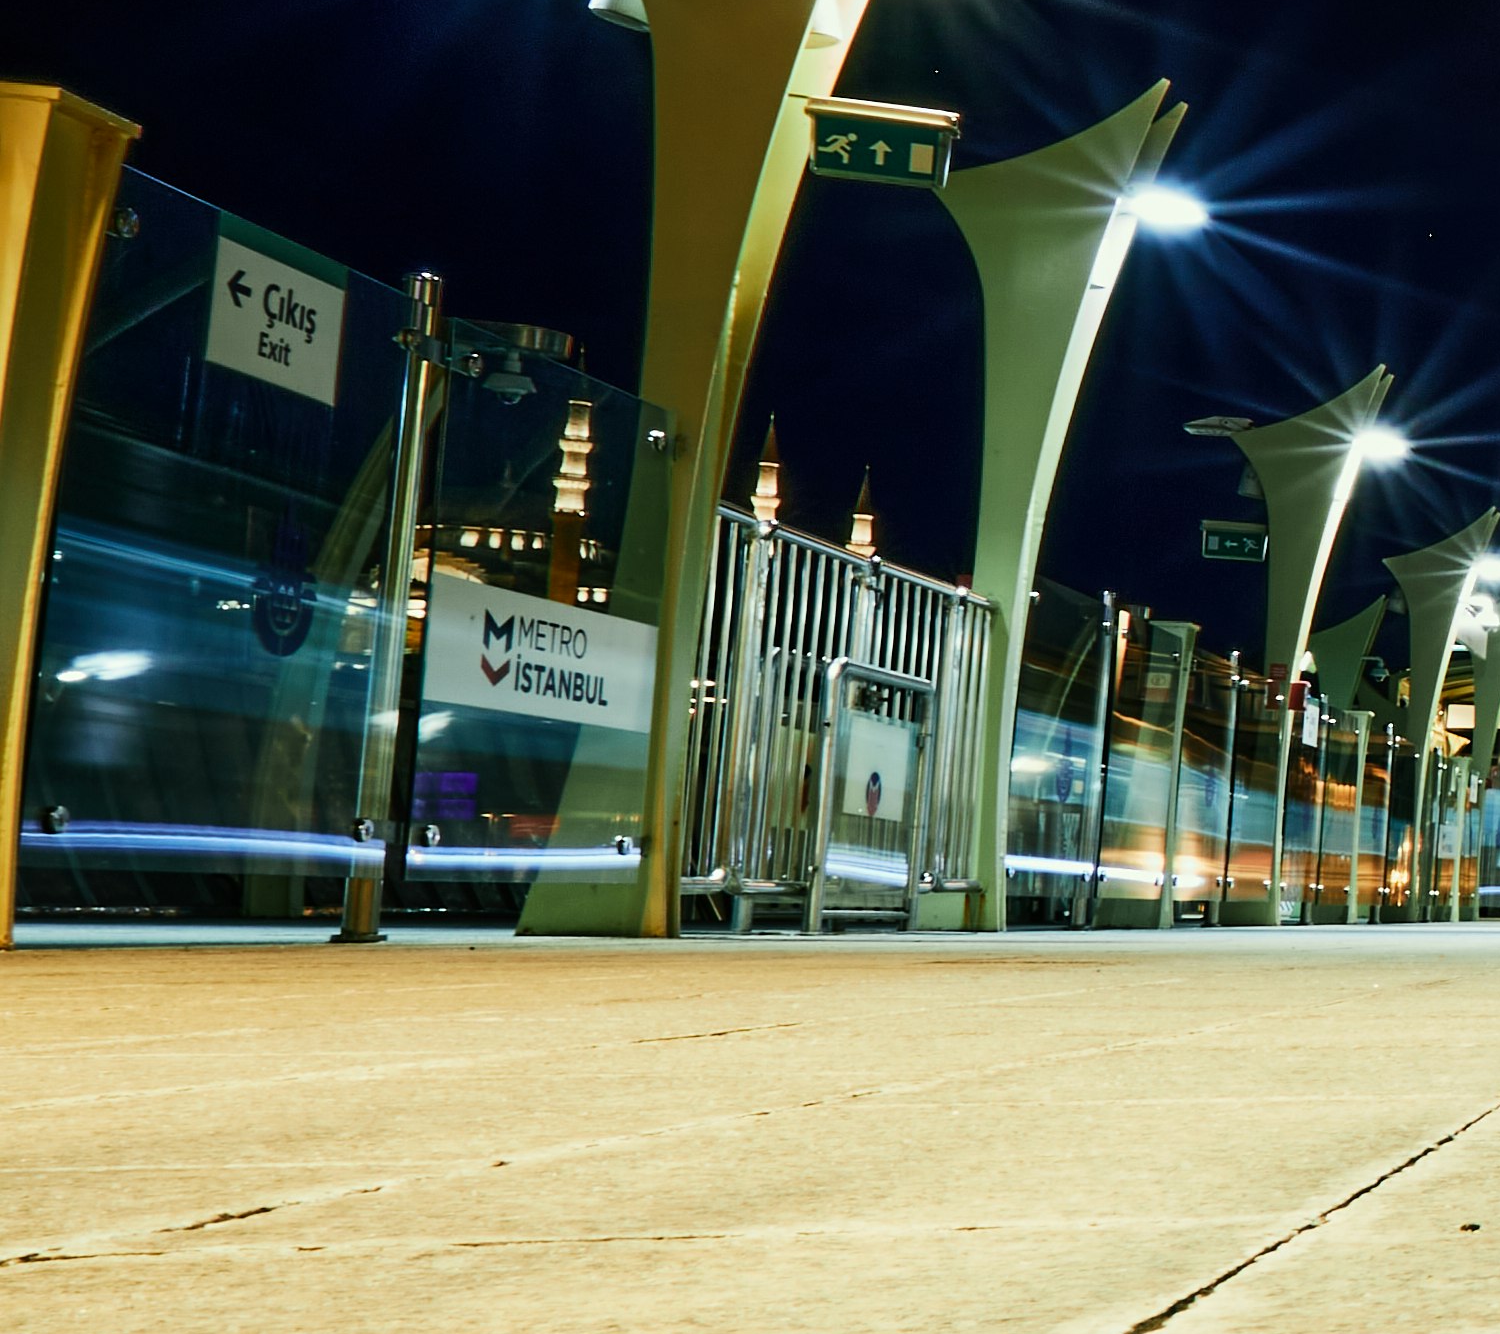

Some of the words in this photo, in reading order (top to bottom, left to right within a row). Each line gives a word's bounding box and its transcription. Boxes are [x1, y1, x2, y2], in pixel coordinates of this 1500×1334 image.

[263, 283, 317, 344] Çıkış
[258, 331, 292, 367] Exit
[518, 616, 588, 659] METRO
[514, 654, 608, 707] İSTANBUL
